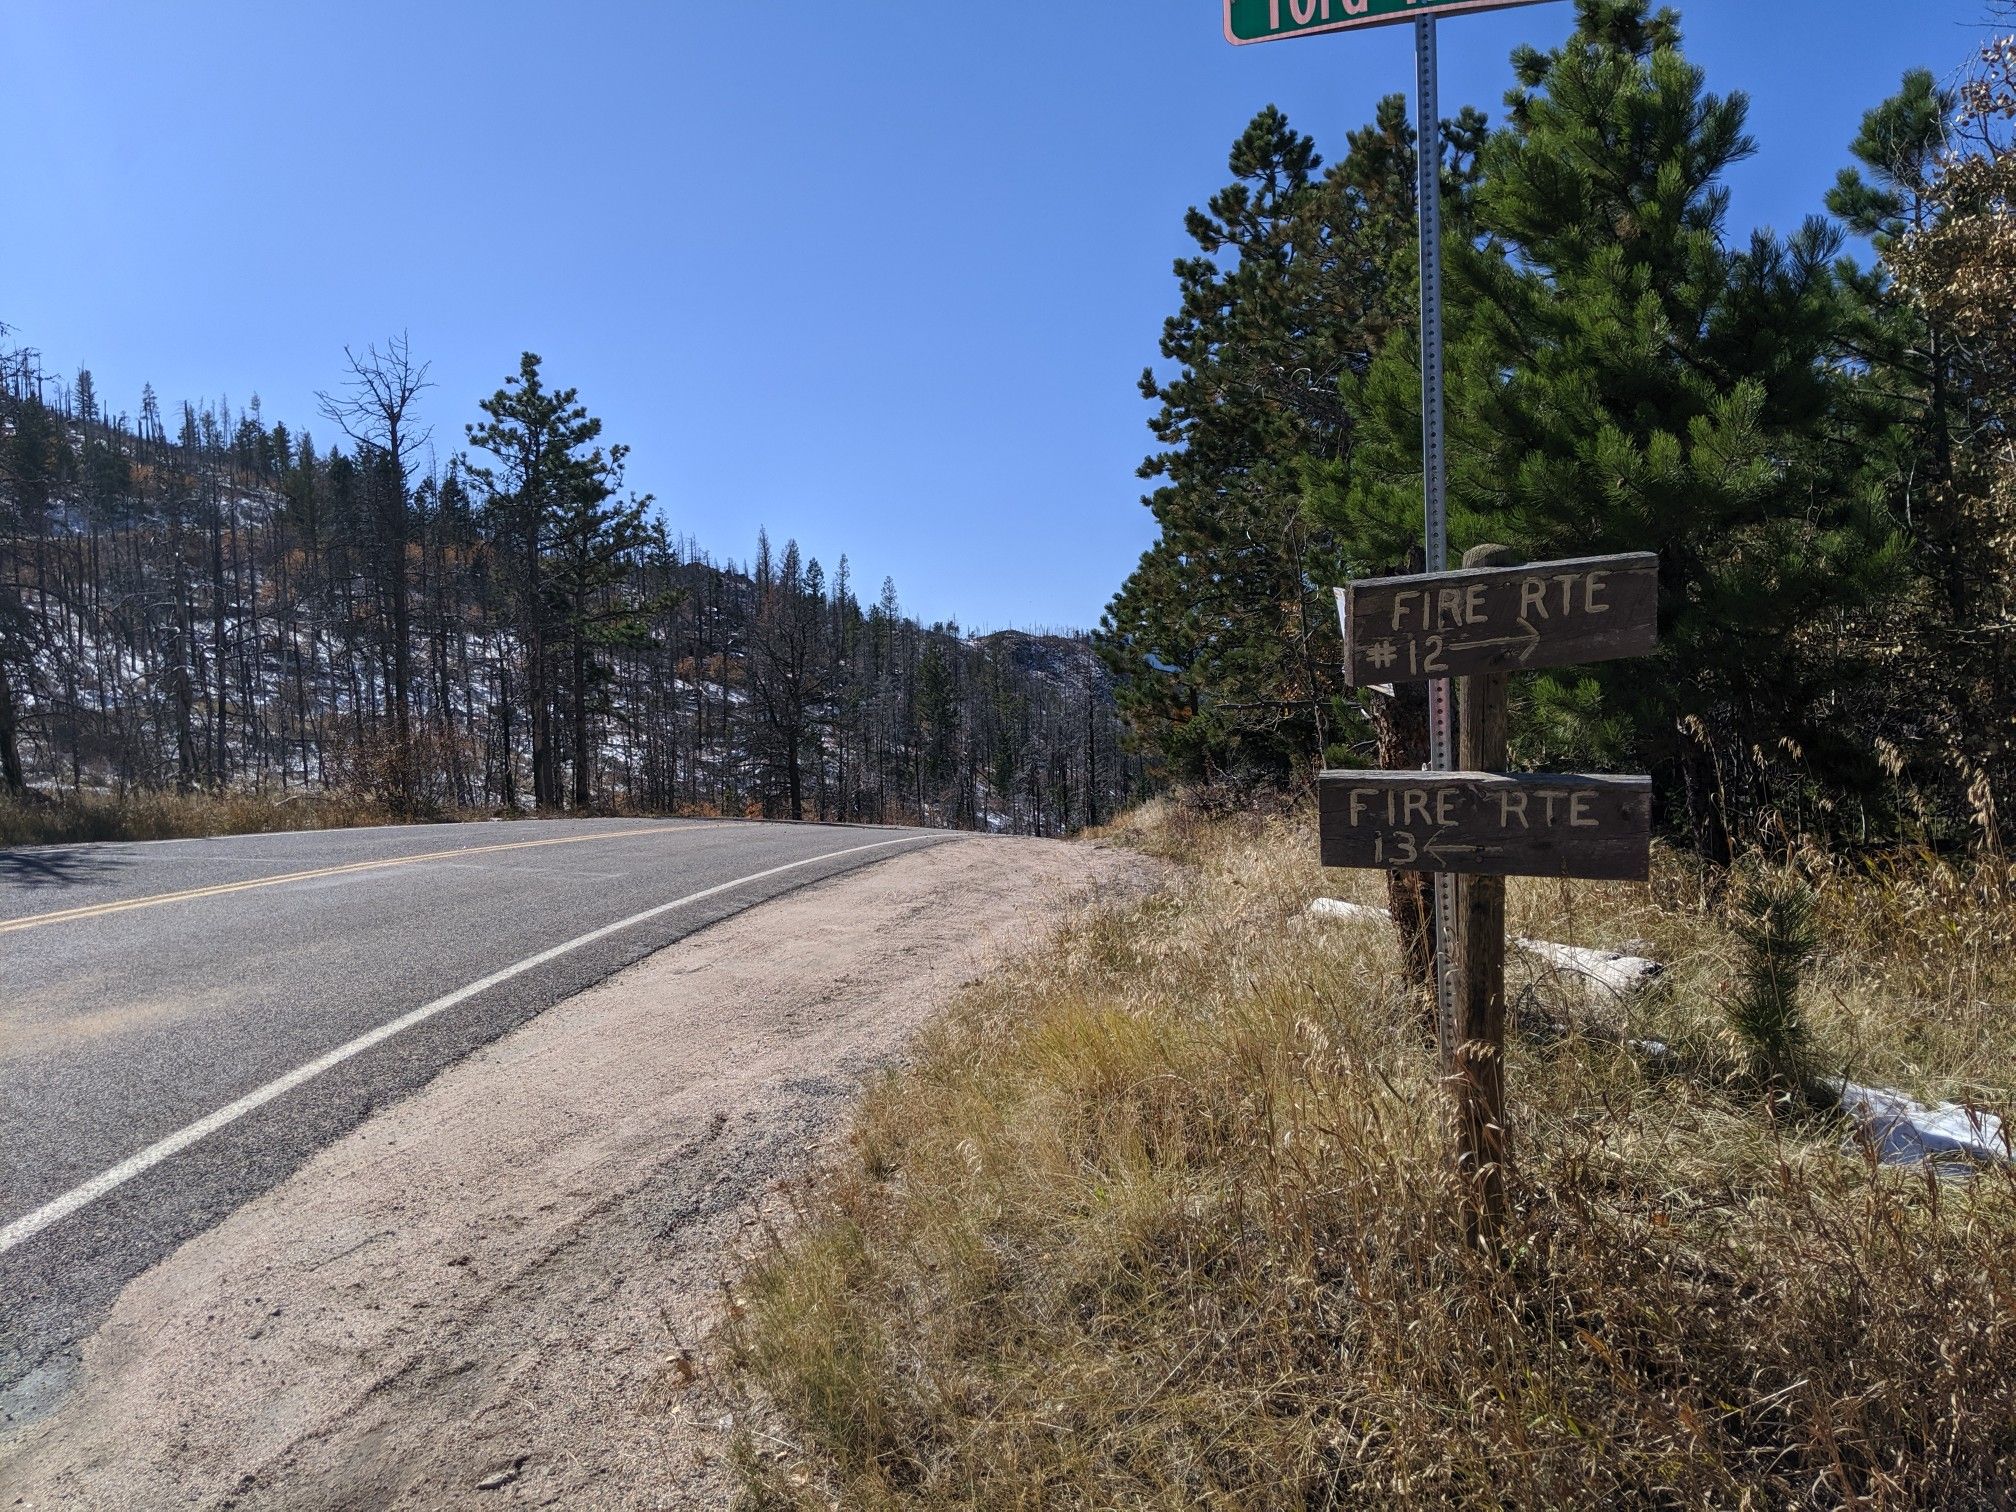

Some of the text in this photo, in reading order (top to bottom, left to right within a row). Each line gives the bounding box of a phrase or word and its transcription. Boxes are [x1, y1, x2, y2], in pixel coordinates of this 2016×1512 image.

[1392, 571, 1609, 631] FIRE RTE
[1366, 634, 1449, 676] #12
[1350, 788, 1600, 829] FIRE RTE
[1374, 830, 1418, 864] 13
